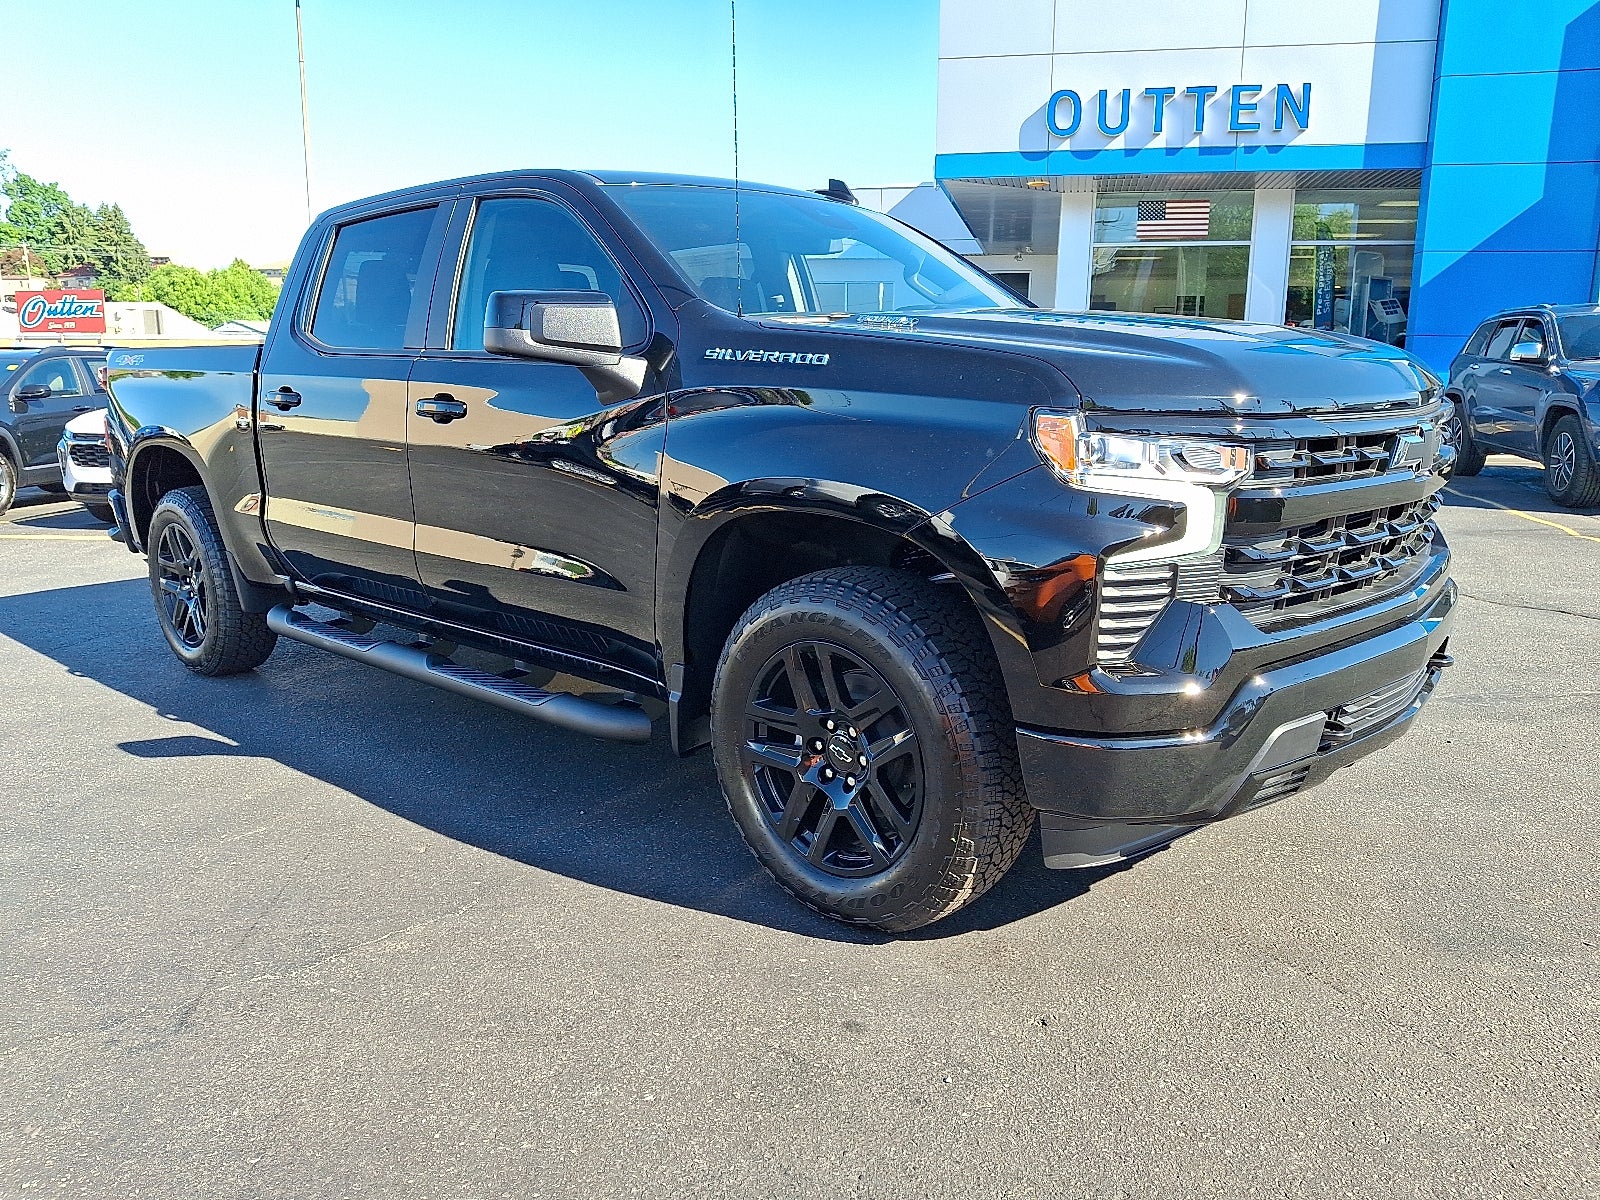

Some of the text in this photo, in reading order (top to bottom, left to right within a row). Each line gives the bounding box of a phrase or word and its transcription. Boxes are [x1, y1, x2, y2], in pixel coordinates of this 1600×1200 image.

[1046, 83, 1312, 137] OUTTEN
[20, 295, 103, 328] Outten
[704, 347, 829, 365] SILVERADO
